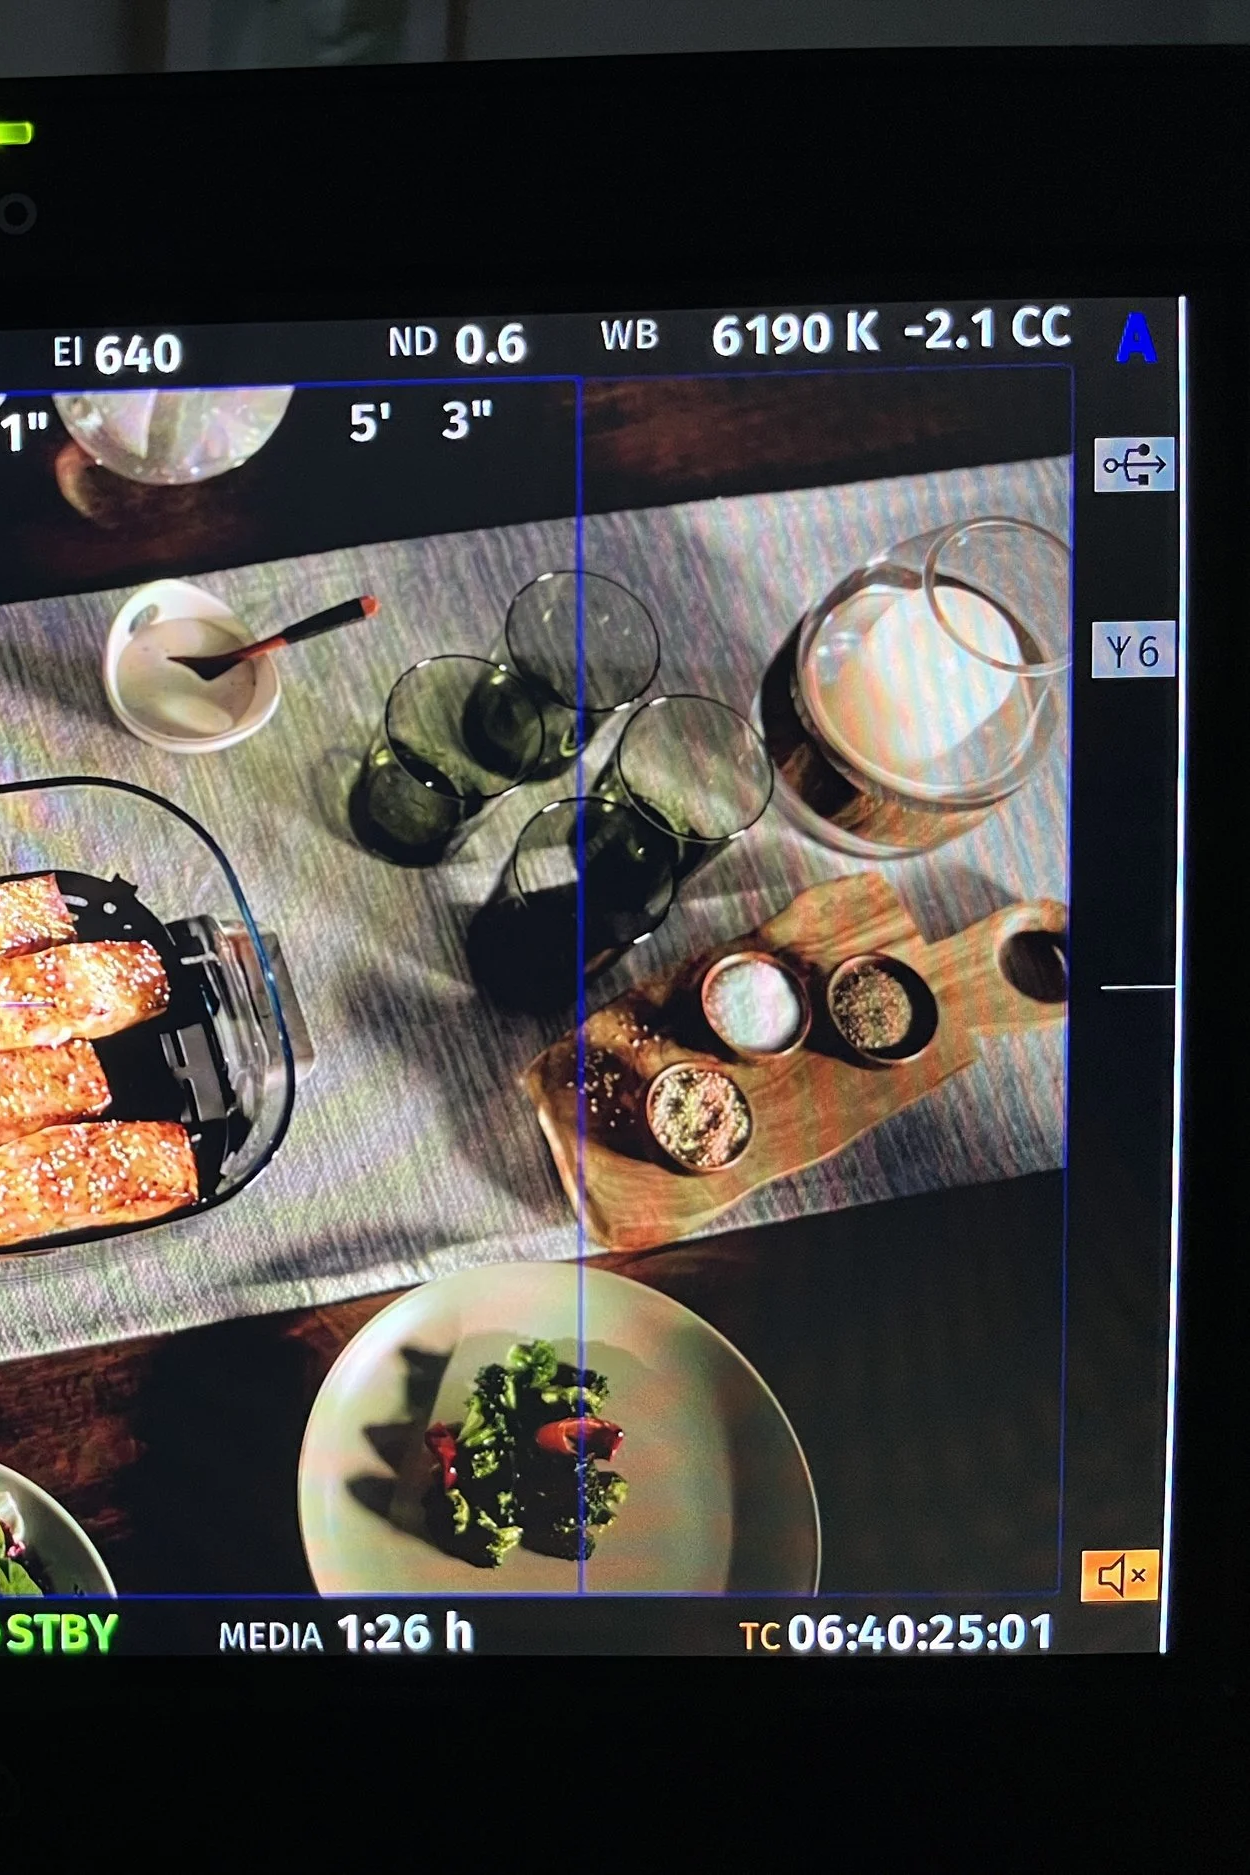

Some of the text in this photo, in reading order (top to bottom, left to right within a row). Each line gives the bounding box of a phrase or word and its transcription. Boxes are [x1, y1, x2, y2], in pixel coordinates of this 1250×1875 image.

[389, 323, 526, 365] ND 0.6
[601, 304, 1073, 356] WB 6190 K -2.1 CC
[1116, 311, 1157, 363] A
[54, 334, 182, 375] EI 640
[6, 1613, 119, 1653] STBY
[218, 1611, 475, 1652] MEDIA 1:26 h
[739, 1612, 1054, 1653] TC 06:40:25:01
